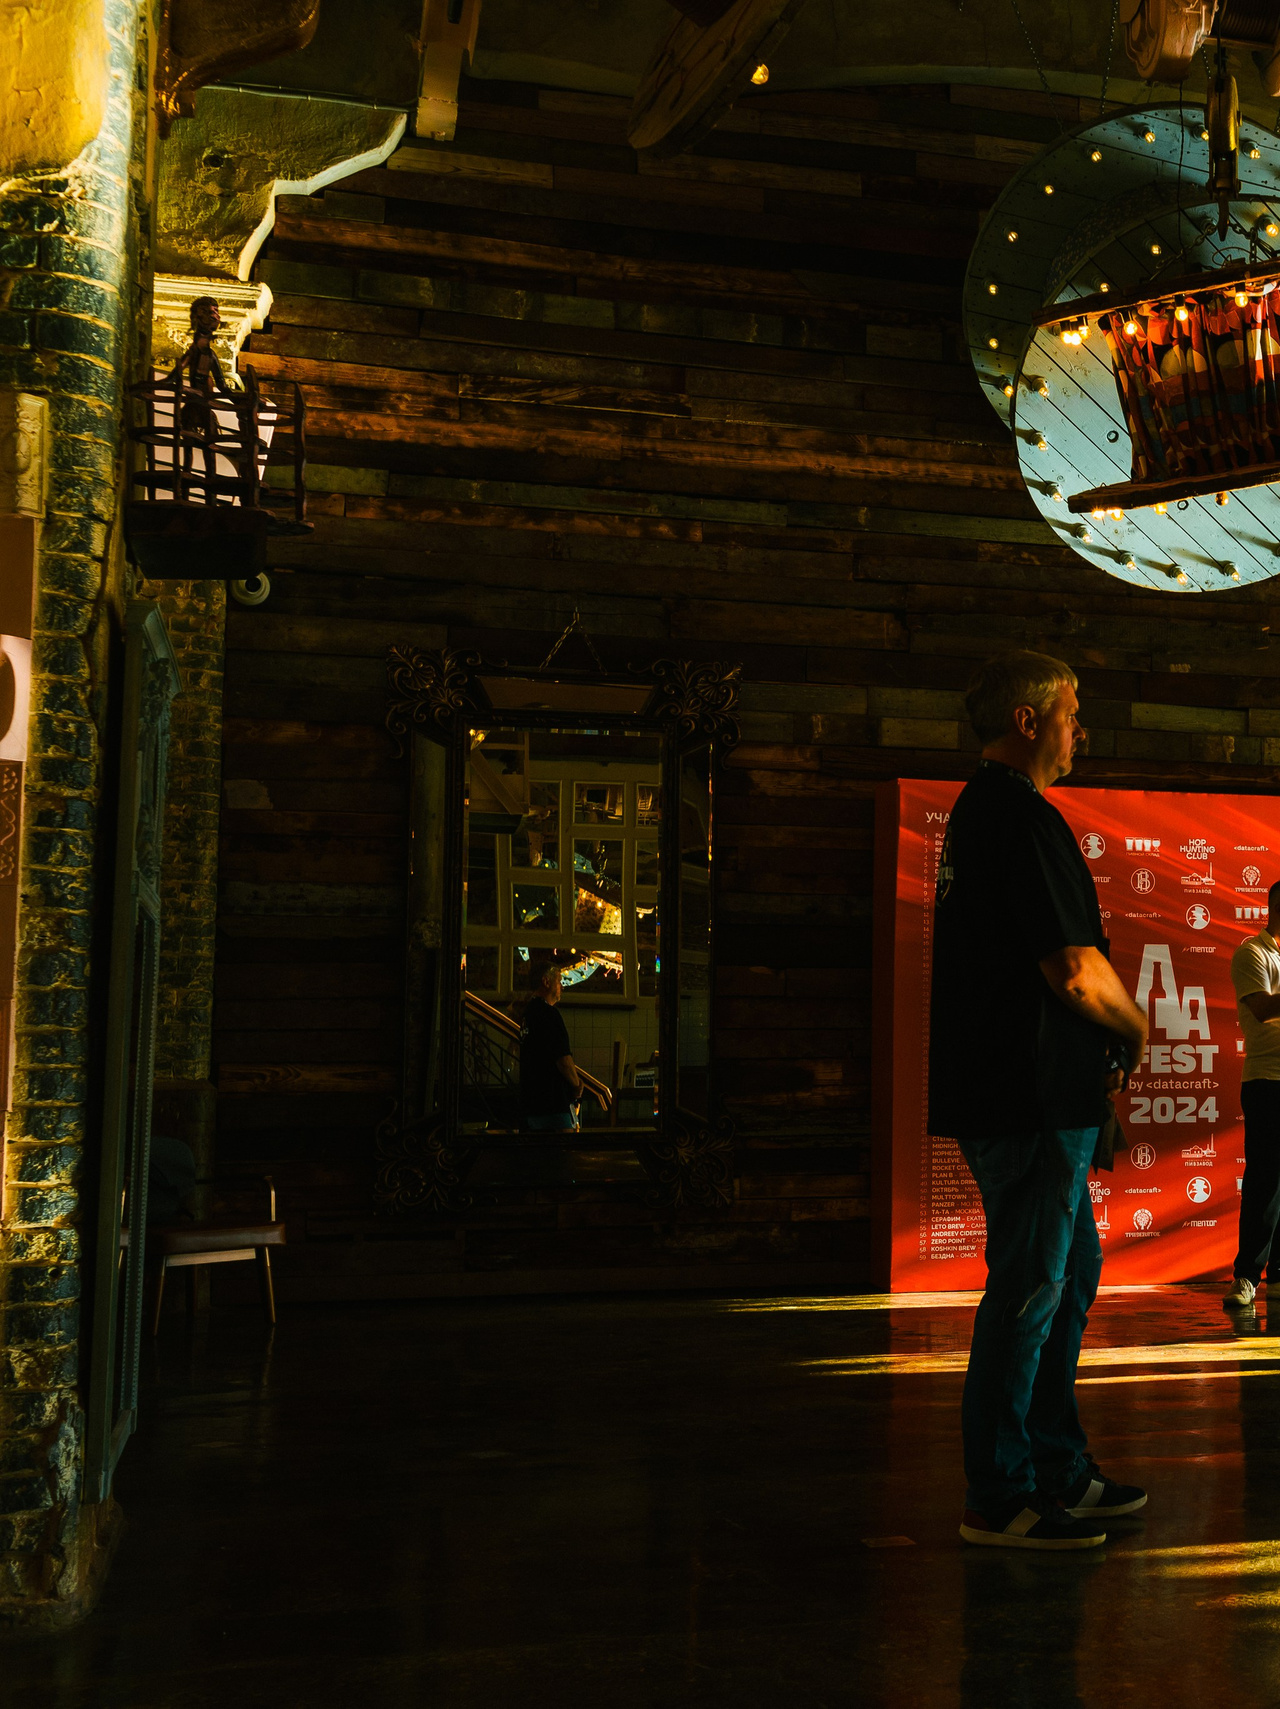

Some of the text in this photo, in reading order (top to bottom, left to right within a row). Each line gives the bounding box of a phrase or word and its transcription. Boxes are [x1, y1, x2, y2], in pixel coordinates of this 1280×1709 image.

[1180, 845, 1216, 853] HUNTING
[1134, 1044, 1219, 1073] FEST
[1129, 1079, 1219, 1092] by <datacraft>
[1129, 1096, 1219, 1124] 2024
[1087, 1181, 1101, 1189] OP
